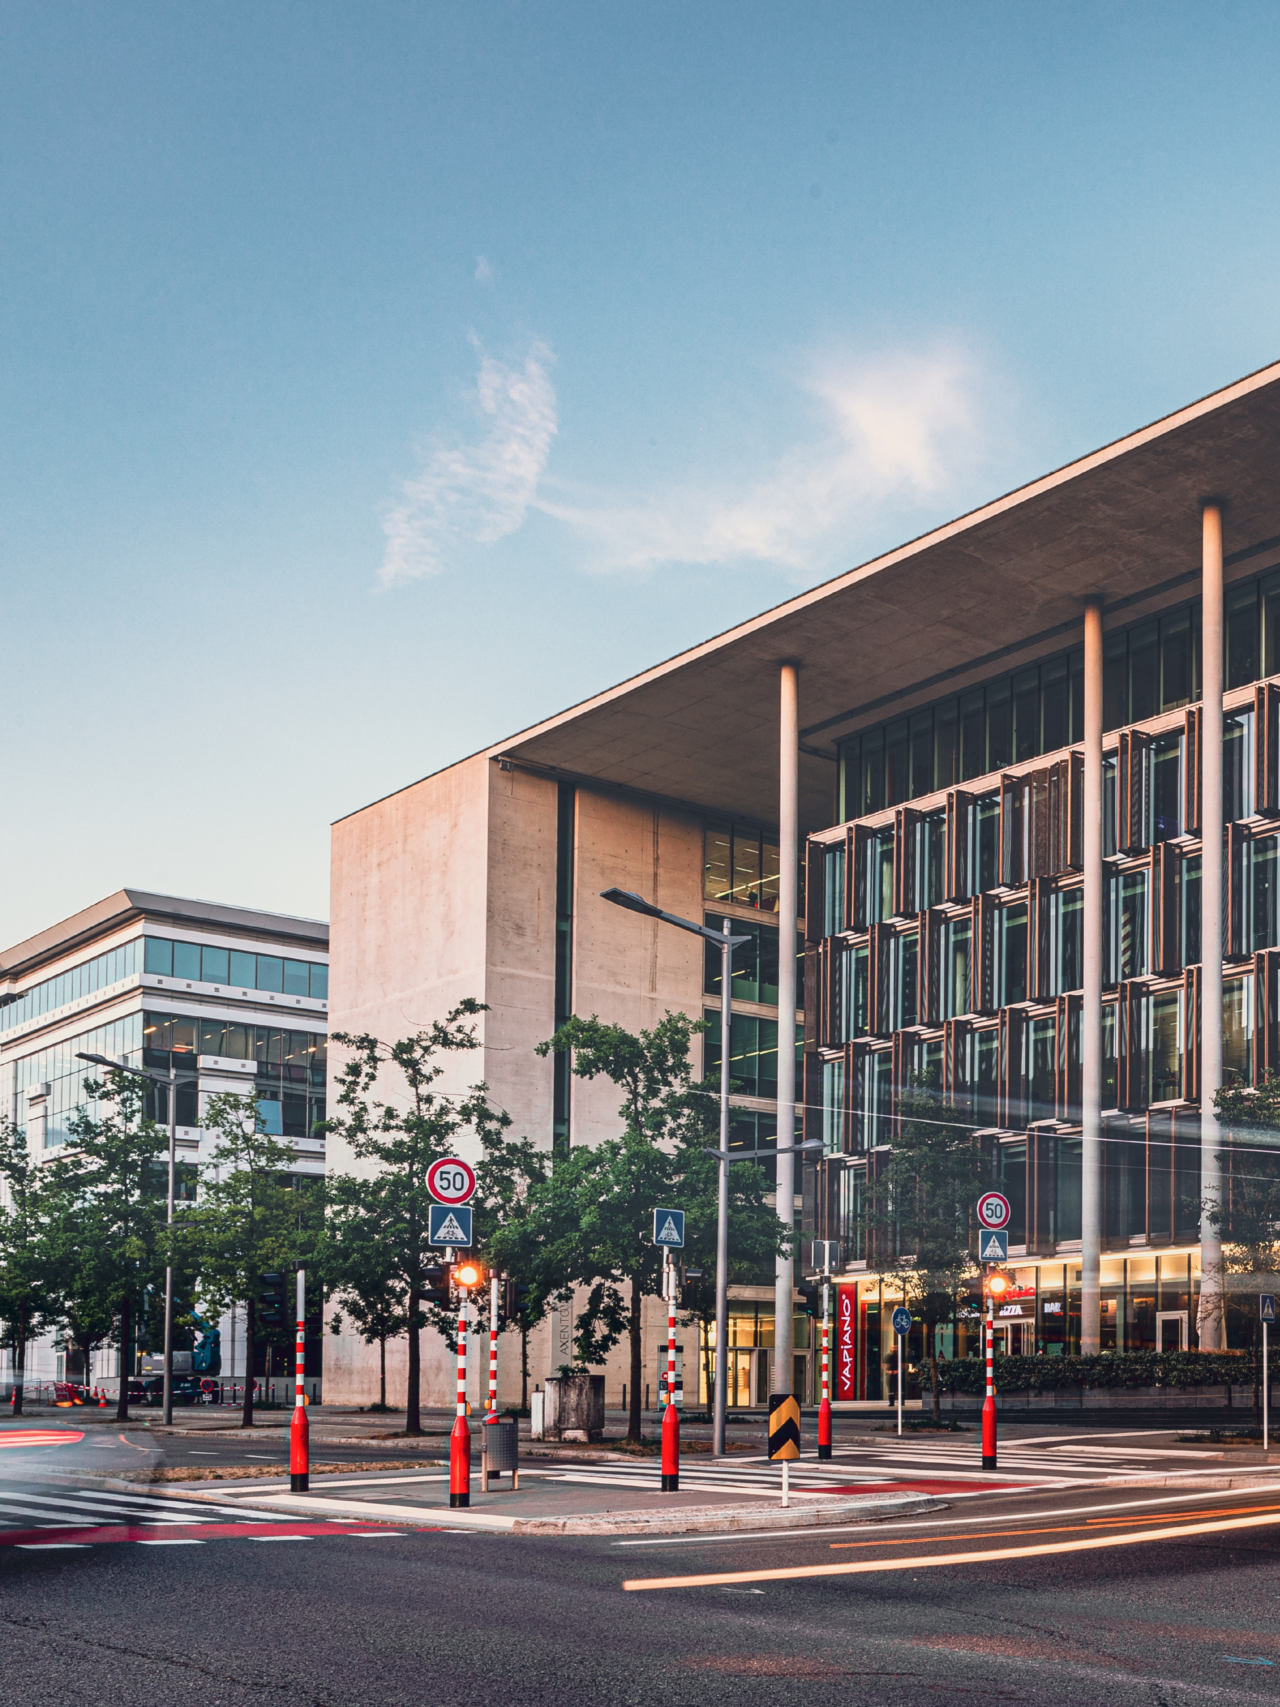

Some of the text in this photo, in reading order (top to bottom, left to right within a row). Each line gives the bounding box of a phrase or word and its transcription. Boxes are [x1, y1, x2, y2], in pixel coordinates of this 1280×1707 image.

[439, 1170, 465, 1192] 50
[986, 1202, 1003, 1219] 50
[559, 1308, 570, 1356] AXENTO
